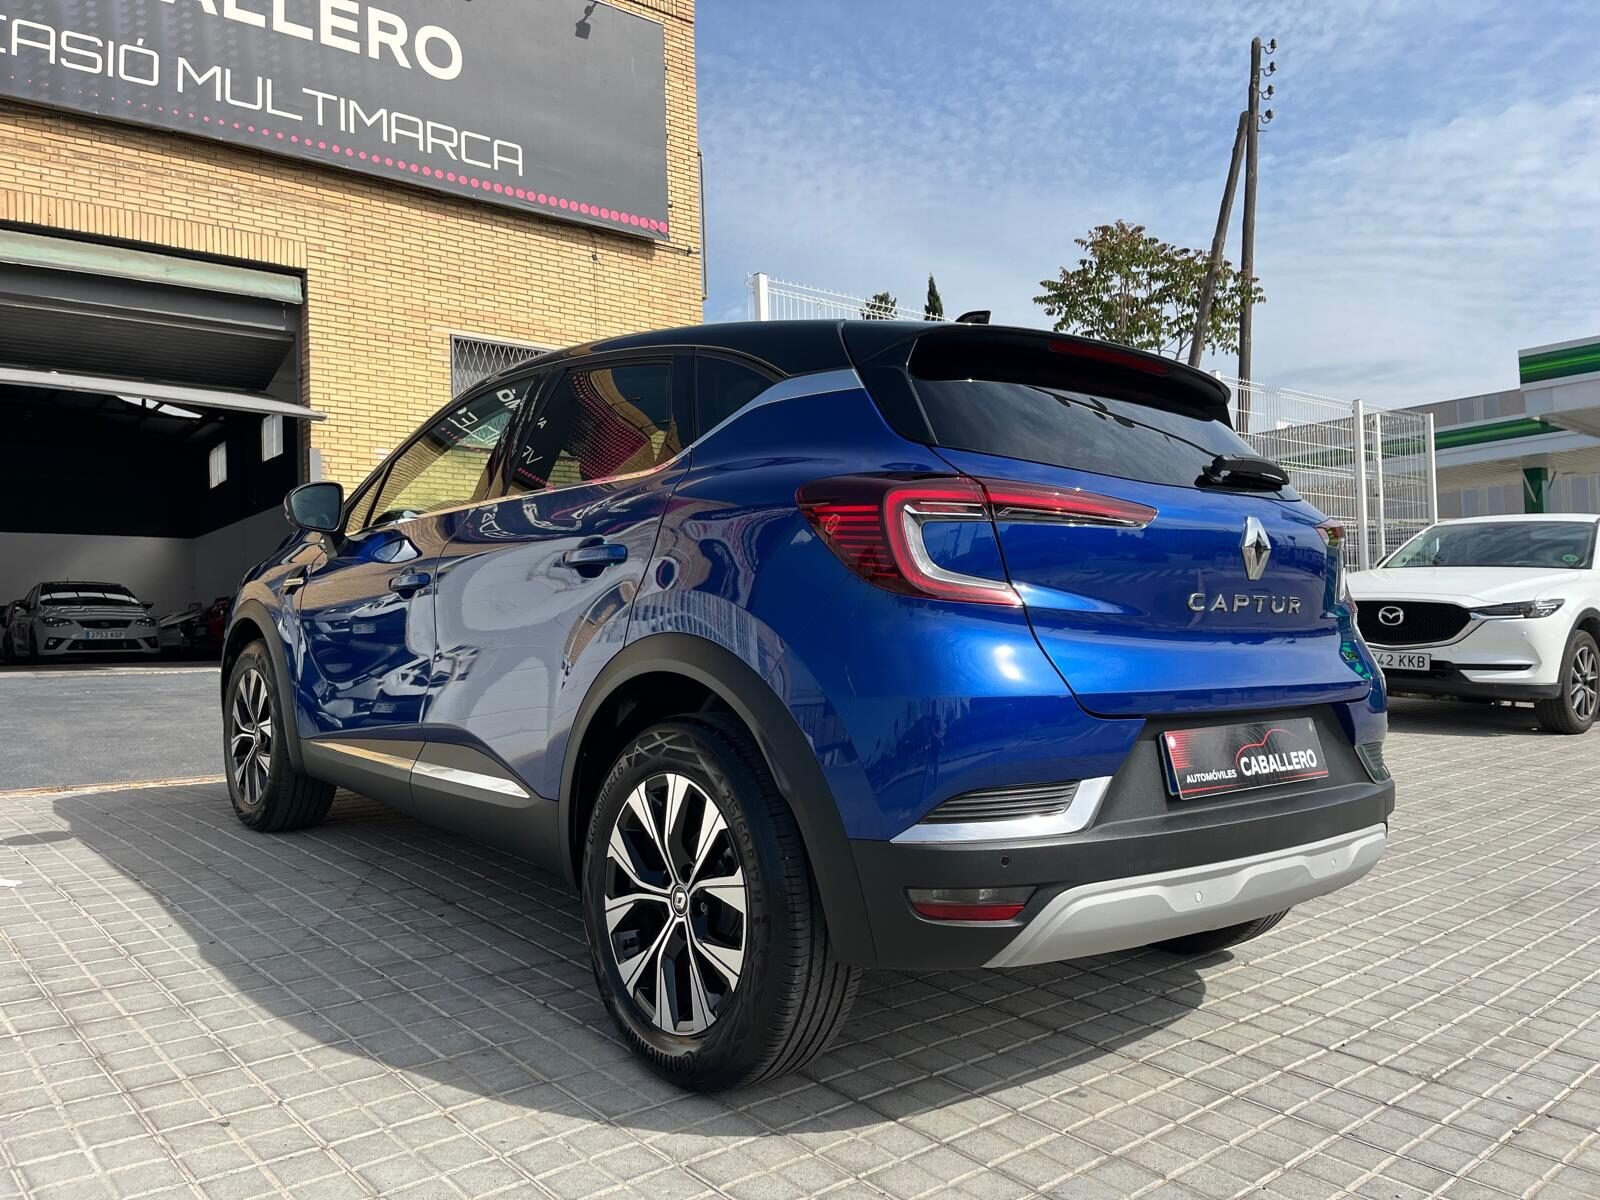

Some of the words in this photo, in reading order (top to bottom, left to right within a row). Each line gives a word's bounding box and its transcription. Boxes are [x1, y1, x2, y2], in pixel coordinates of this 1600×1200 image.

[161, 0, 463, 80] LLERO
[0, 13, 160, 87] ASIÓ
[177, 56, 523, 176] MULTIMARCA
[1187, 592, 1301, 615] CAPTUR
[1373, 653, 1394, 667] 42
[1398, 654, 1426, 669] KKB
[617, 762, 624, 776] 6
[1186, 768, 1237, 784] AUTOMÓVILES
[1239, 749, 1318, 777] CABALLERO
